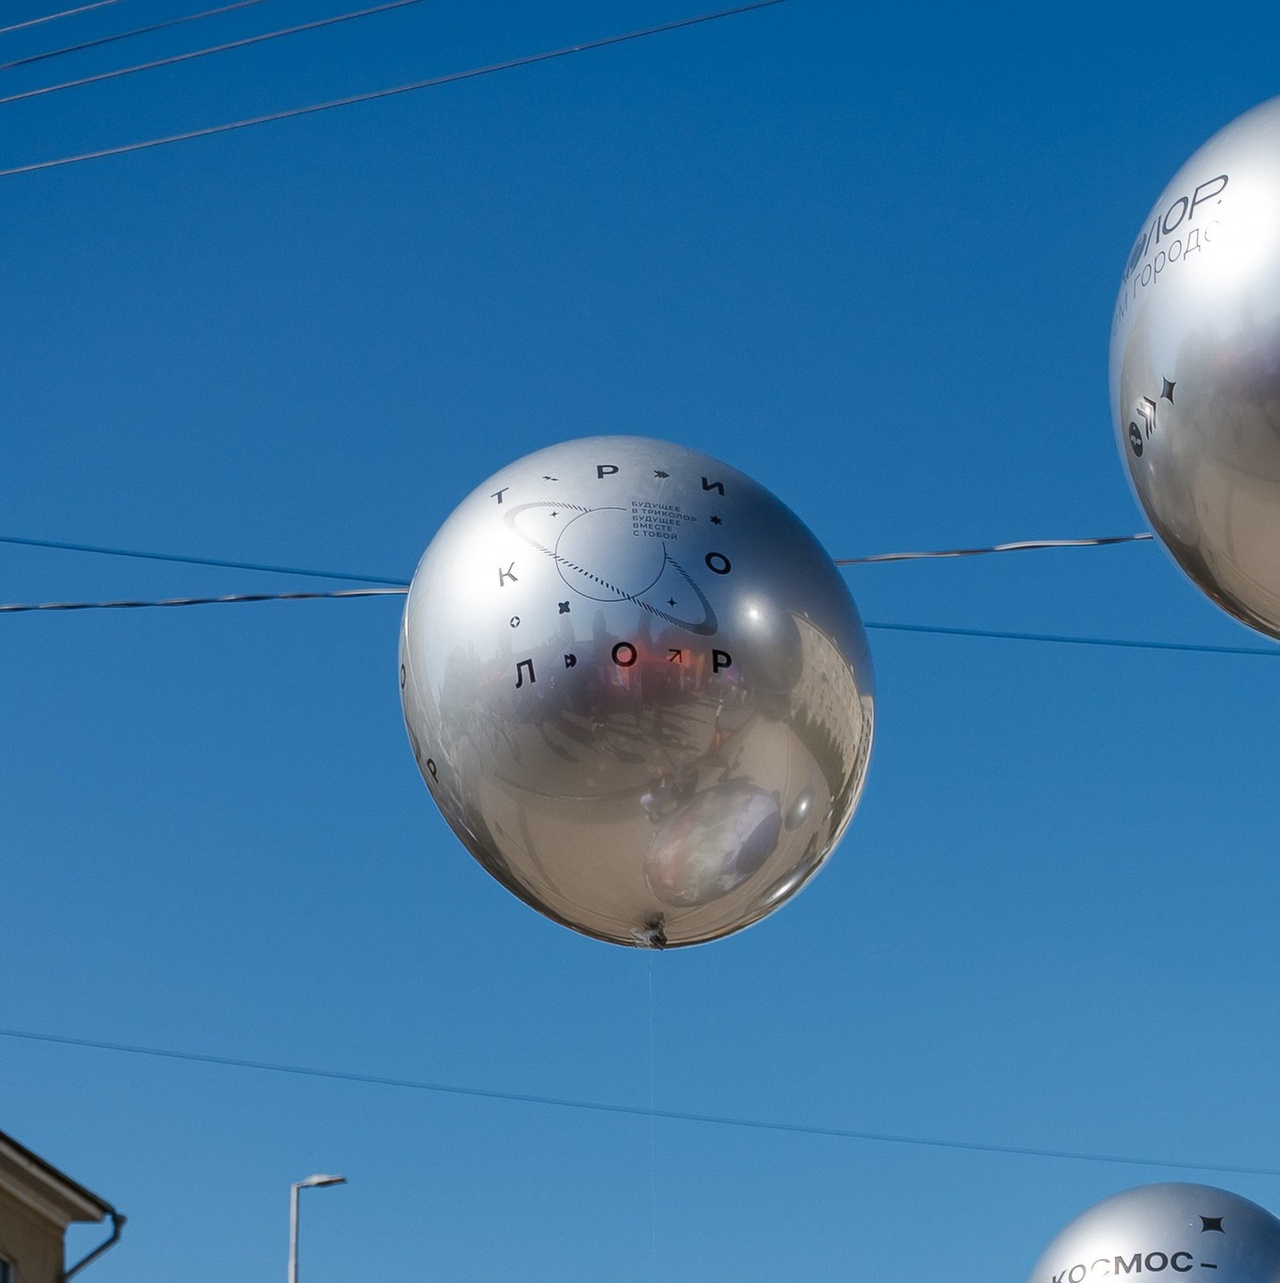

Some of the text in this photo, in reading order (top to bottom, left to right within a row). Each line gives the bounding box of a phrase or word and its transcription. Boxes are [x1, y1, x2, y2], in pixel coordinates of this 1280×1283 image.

[631, 501, 681, 513] БУДУЩЕЕ
[632, 515, 682, 527] БУДУЩЕЕ
[632, 522, 673, 532] ВМЕСТЕ
